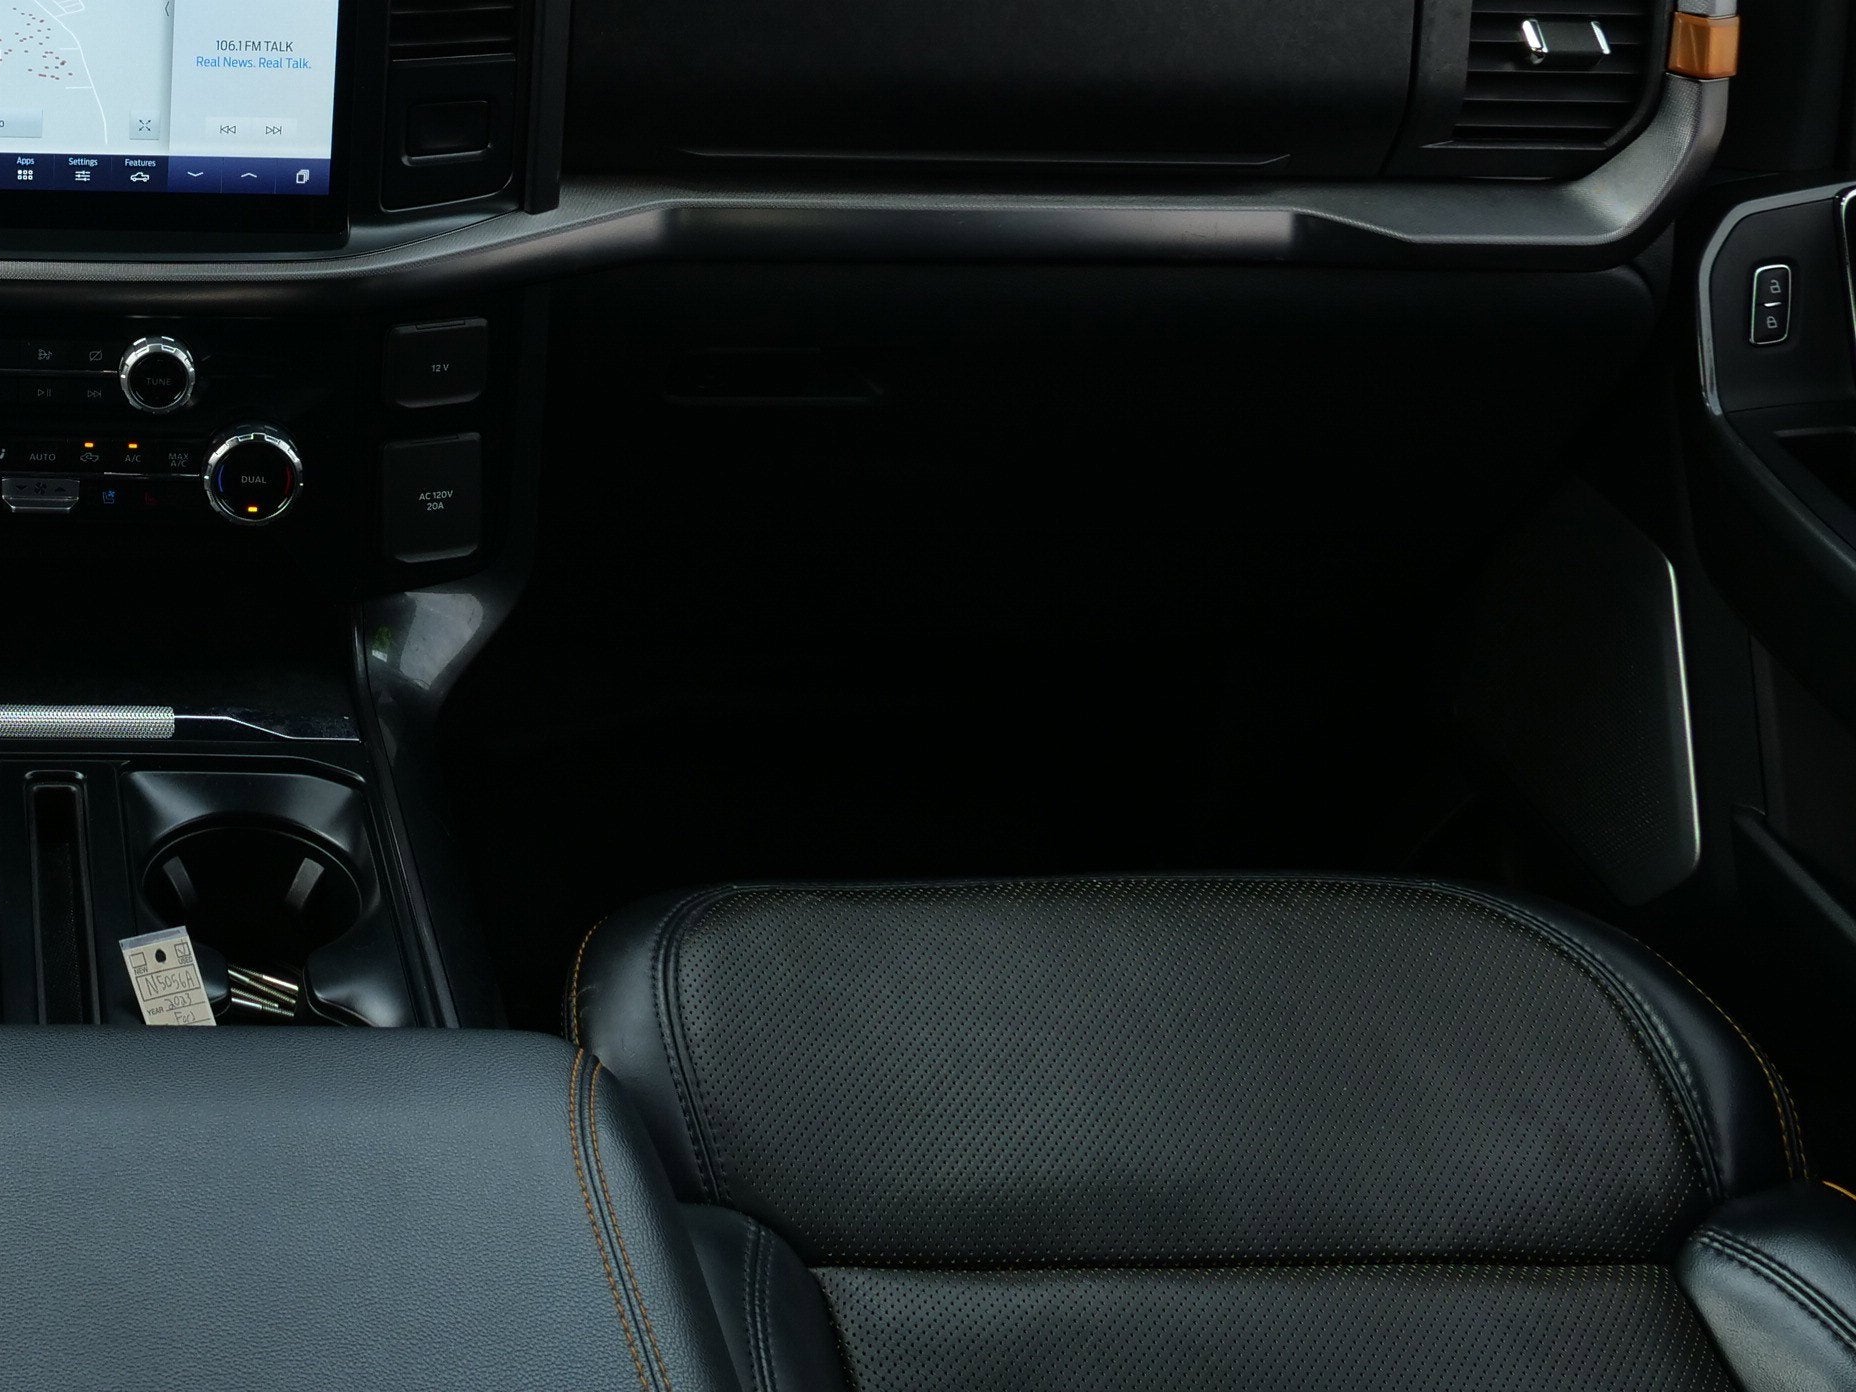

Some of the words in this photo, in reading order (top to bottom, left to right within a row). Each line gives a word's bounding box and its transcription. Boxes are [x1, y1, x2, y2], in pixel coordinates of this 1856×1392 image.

[216, 40, 243, 52] 106.1
[245, 41, 261, 51] FM
[264, 41, 293, 52] TALK
[196, 56, 220, 67] Real
[223, 57, 254, 68] News.
[259, 57, 283, 68] Real
[287, 58, 311, 69] Talk.
[16, 157, 35, 167] Apps
[68, 157, 98, 168] Settings
[124, 159, 156, 168] Features
[431, 364, 441, 372] 12
[147, 377, 171, 386] TUNE
[29, 453, 56, 462] AUTO
[125, 454, 141, 464] A/C
[168, 452, 189, 460] MAX
[170, 459, 187, 468] A/C
[241, 475, 266, 484] DUAL
[419, 492, 431, 501] AC
[433, 490, 453, 500] 120V
[427, 502, 444, 511] 20A
[178, 955, 193, 964] USED
[134, 967, 148, 976] NEW
[147, 1007, 164, 1016] YEAR
